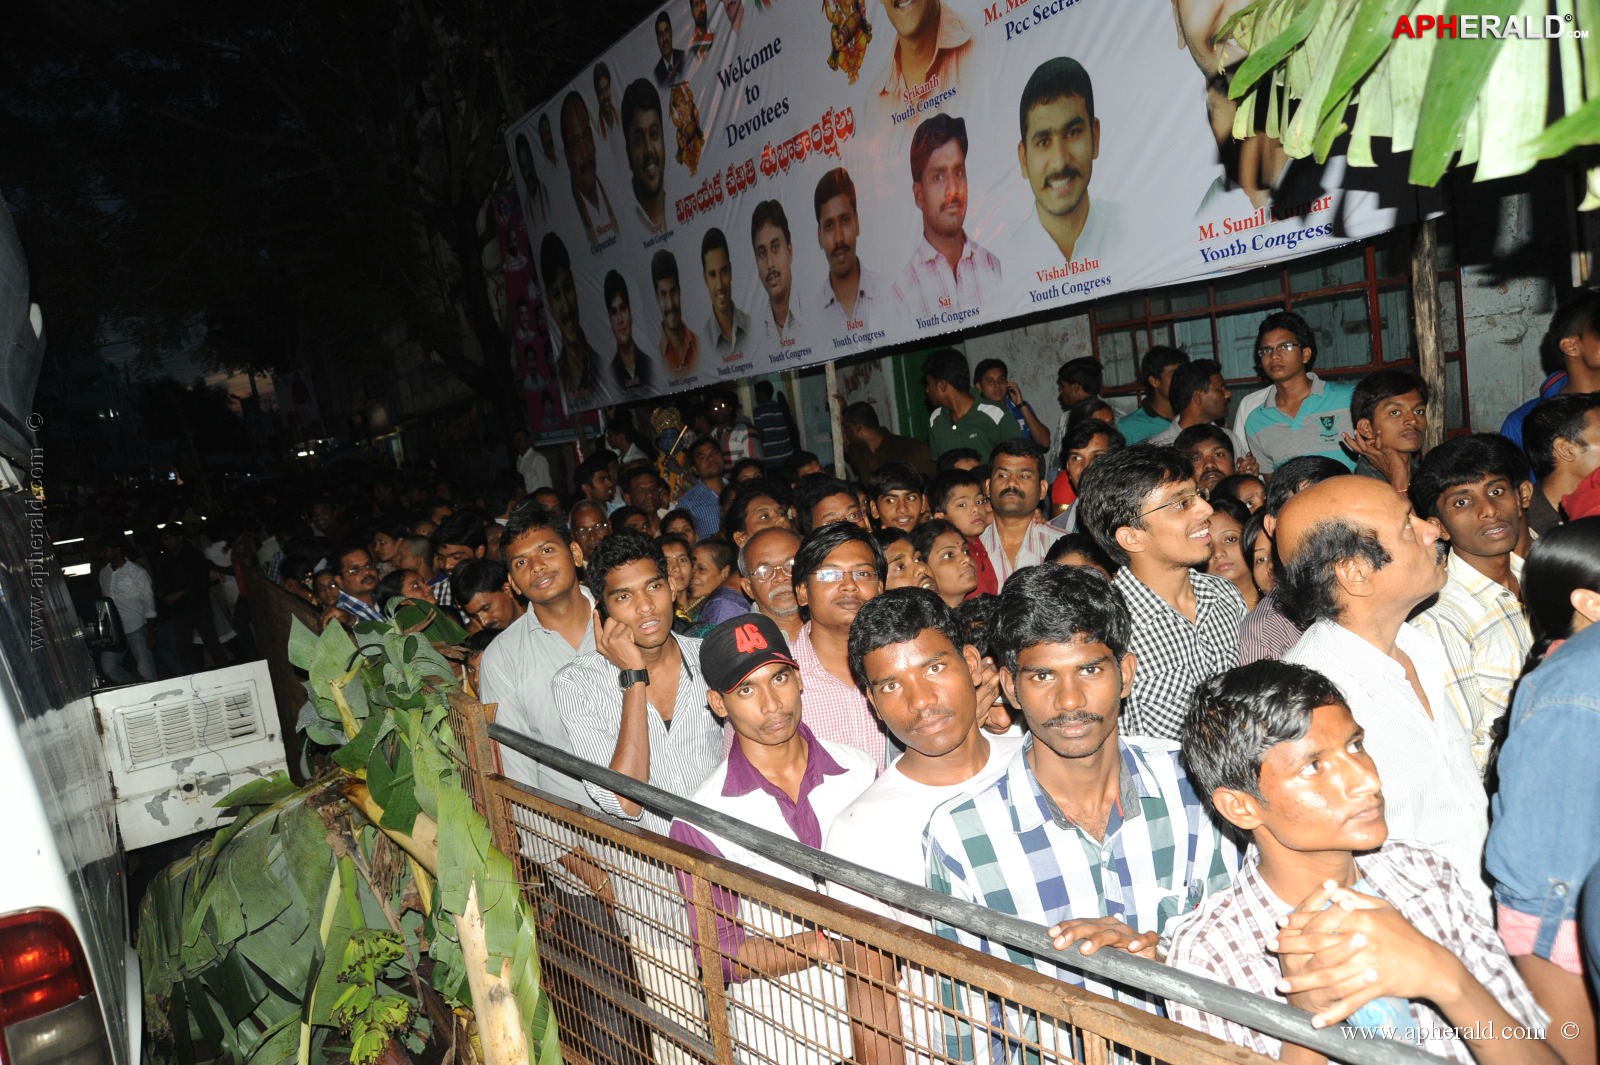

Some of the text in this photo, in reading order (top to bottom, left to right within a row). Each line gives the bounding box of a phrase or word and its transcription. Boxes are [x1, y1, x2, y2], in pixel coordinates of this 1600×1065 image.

[984, 3, 1002, 25] M.
[1005, 17, 1030, 40] Pcc
[716, 37, 782, 91] Welcome
[745, 85, 760, 105] to
[903, 75, 939, 102] Srikanth
[891, 87, 957, 125] Youth Congress
[725, 97, 789, 149] Devotees
[1199, 222, 1220, 242] M.
[1223, 208, 1265, 235] Sunil
[1200, 222, 1333, 264] Youth Congress
[1036, 257, 1099, 283] Vishal Babu
[938, 296, 952, 308] Sai
[1029, 275, 1111, 303] Youth Congress
[846, 319, 864, 331] Babu
[916, 307, 980, 329] Youth Congress
[832, 329, 886, 348] Youth Congress
[768, 347, 813, 363] Youth Congress
[735, 623, 768, 654] 46
